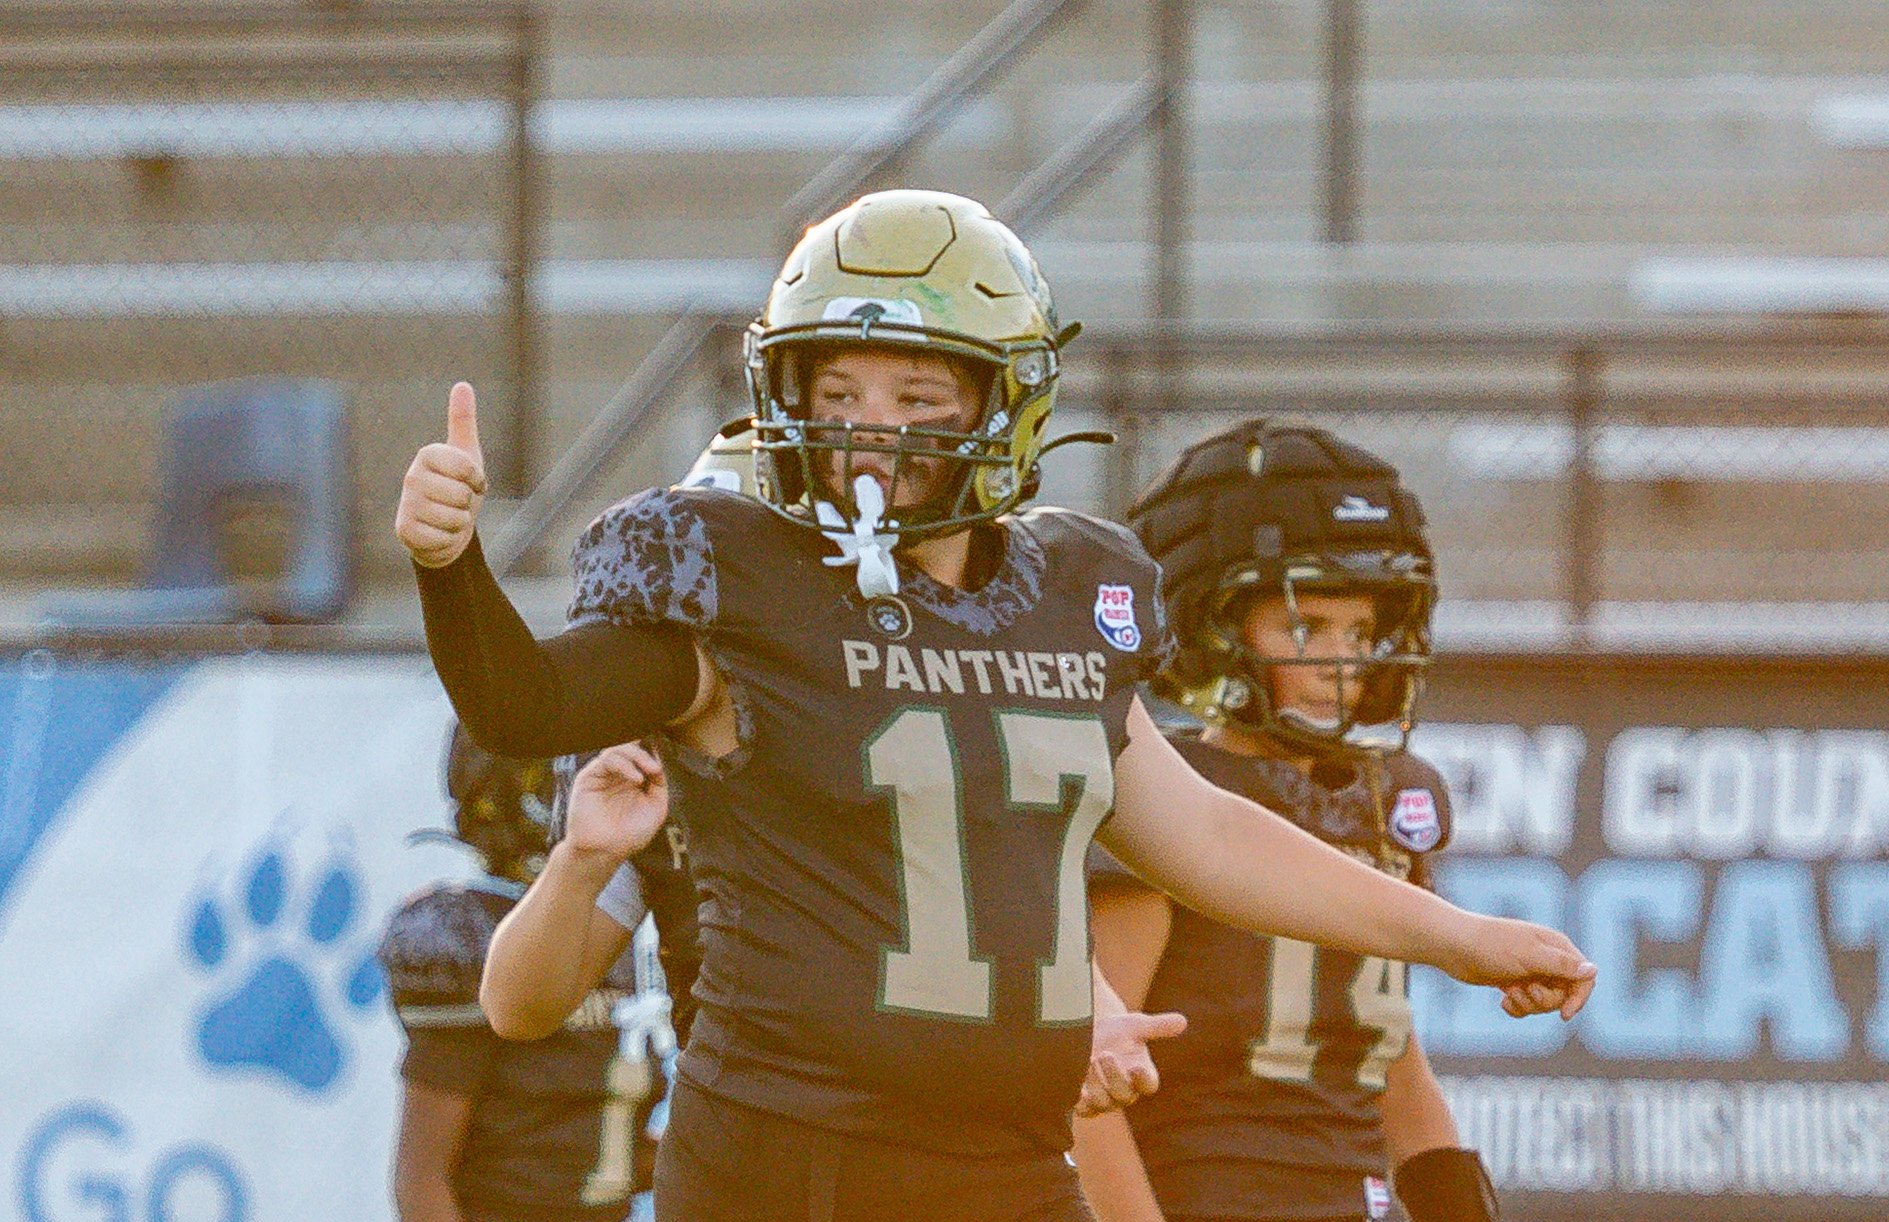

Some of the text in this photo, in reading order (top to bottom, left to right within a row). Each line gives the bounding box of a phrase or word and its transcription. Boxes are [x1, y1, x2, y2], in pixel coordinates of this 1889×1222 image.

[1101, 590, 1129, 605] POP
[842, 640, 1106, 700] PANTHERS
[862, 705, 1114, 1028] 17
[1618, 1080, 1736, 1195] THIS
